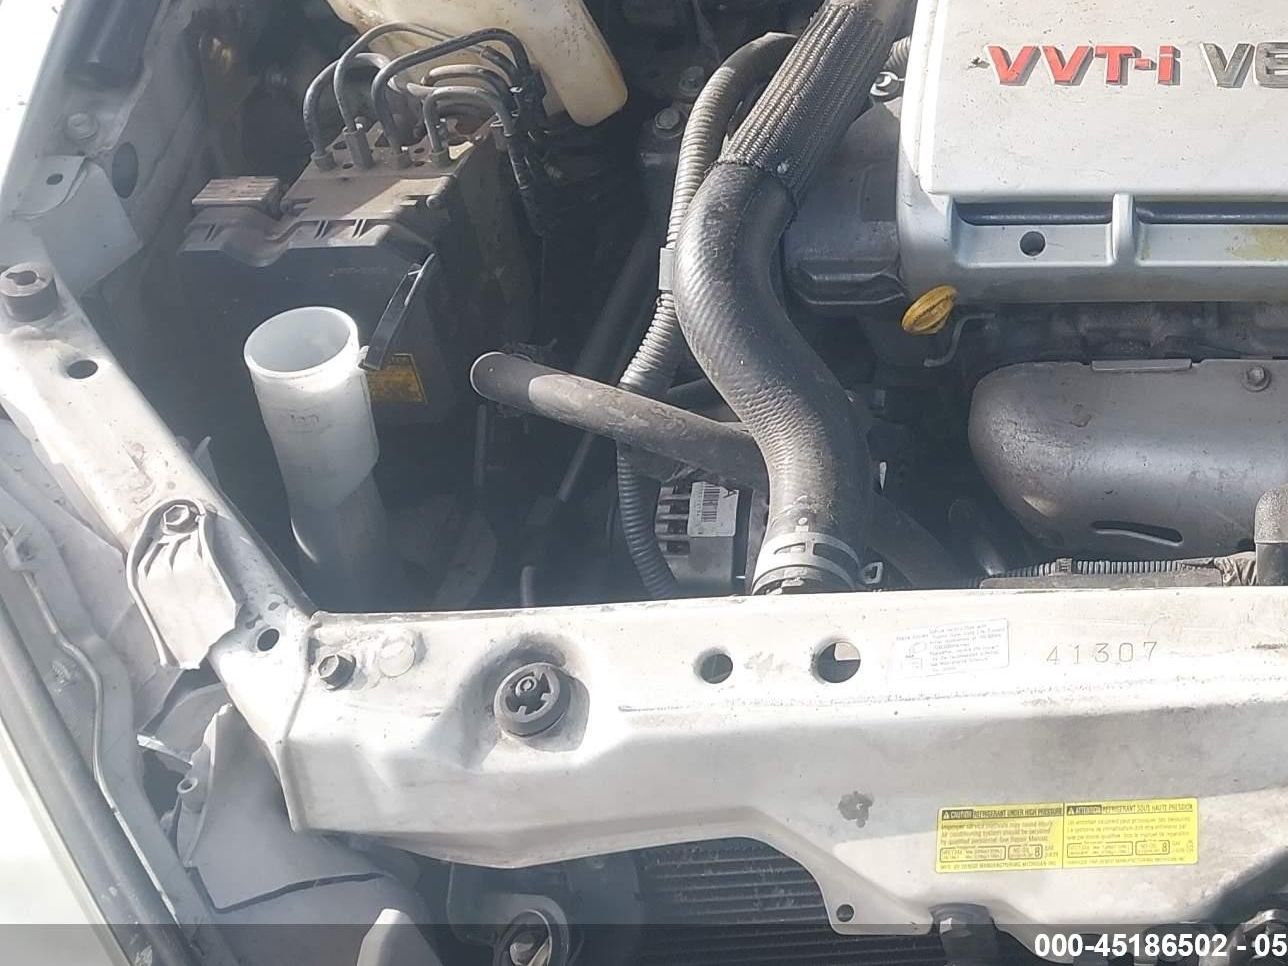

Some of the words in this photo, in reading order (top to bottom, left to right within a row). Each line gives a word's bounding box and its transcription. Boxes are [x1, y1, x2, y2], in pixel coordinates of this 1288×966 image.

[986, 42, 1181, 86] VVT-i
[1046, 641, 1158, 665] 41307
[951, 810, 973, 819] CAUTION
[1034, 846, 1041, 857] 8
[1161, 841, 1168, 852] 8
